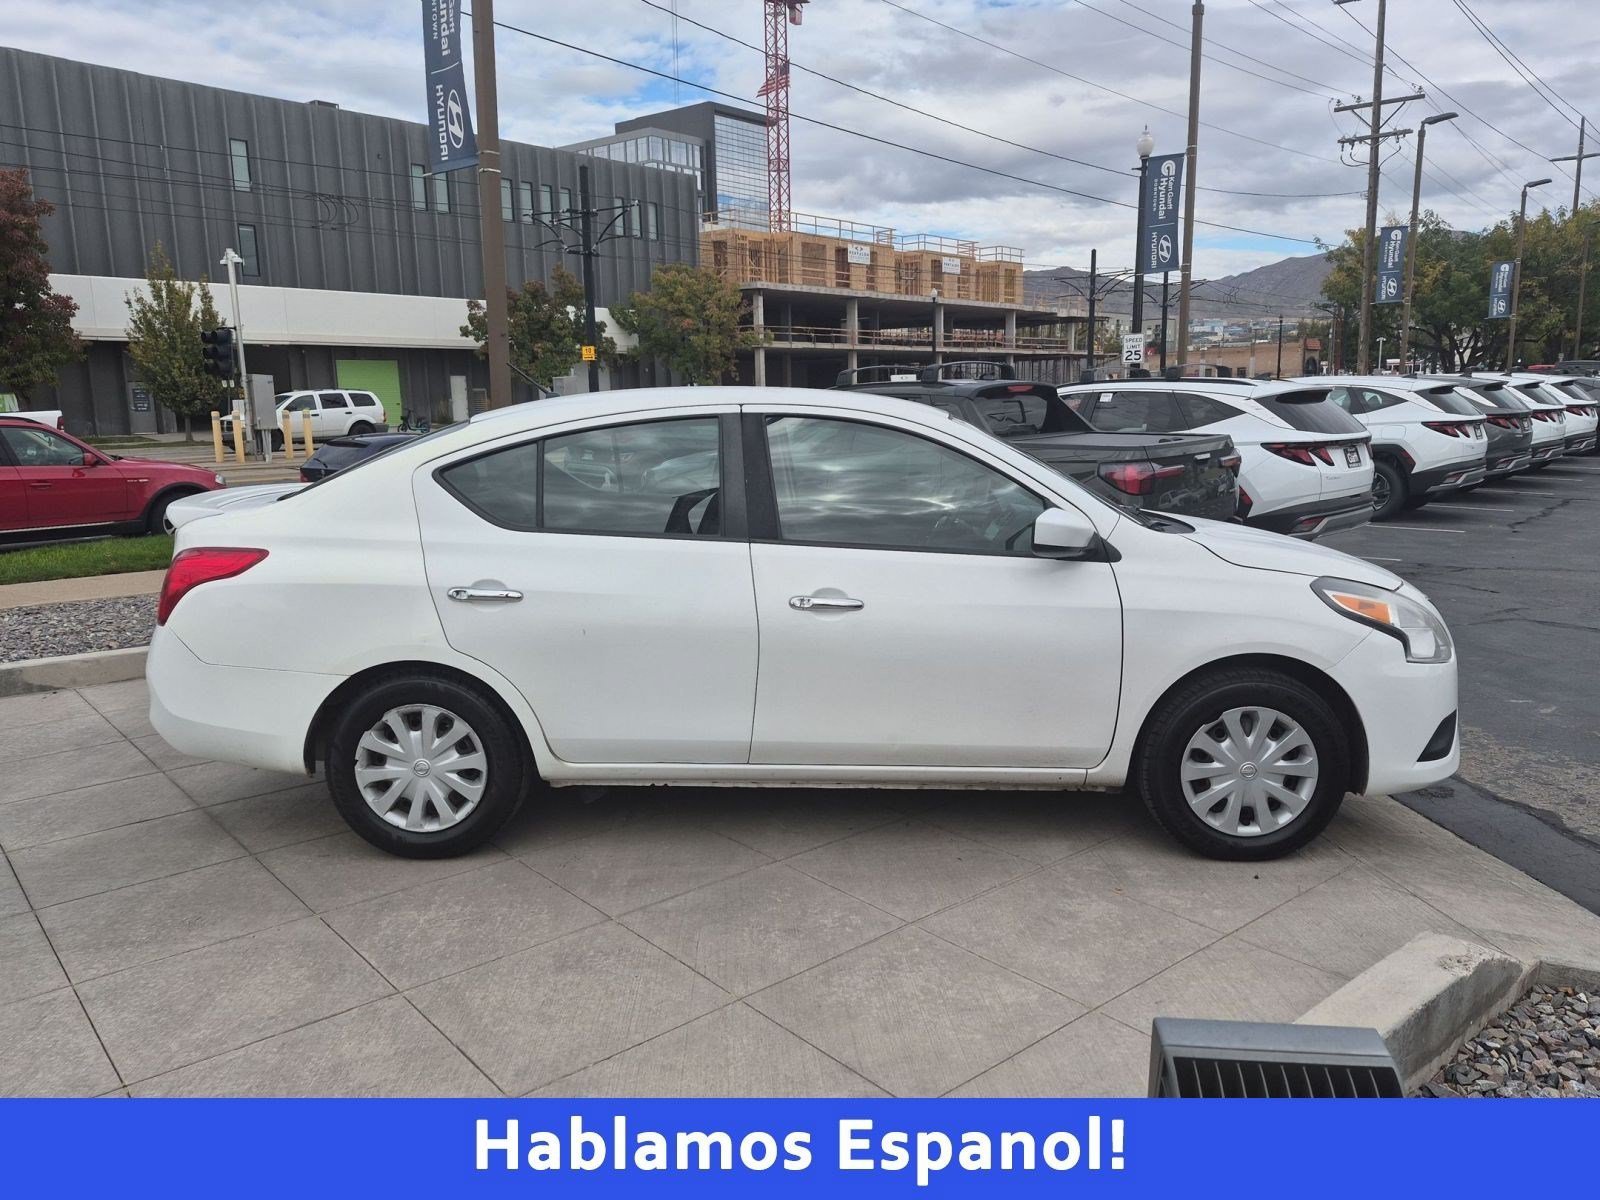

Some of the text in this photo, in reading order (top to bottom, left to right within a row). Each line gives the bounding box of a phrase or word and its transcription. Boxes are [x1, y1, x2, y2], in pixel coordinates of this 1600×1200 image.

[436, 84, 449, 161] HYUNDAI
[1158, 178, 1168, 219] Hyundai
[1388, 241, 1396, 268] Hyundai
[1125, 350, 1142, 361] 25
